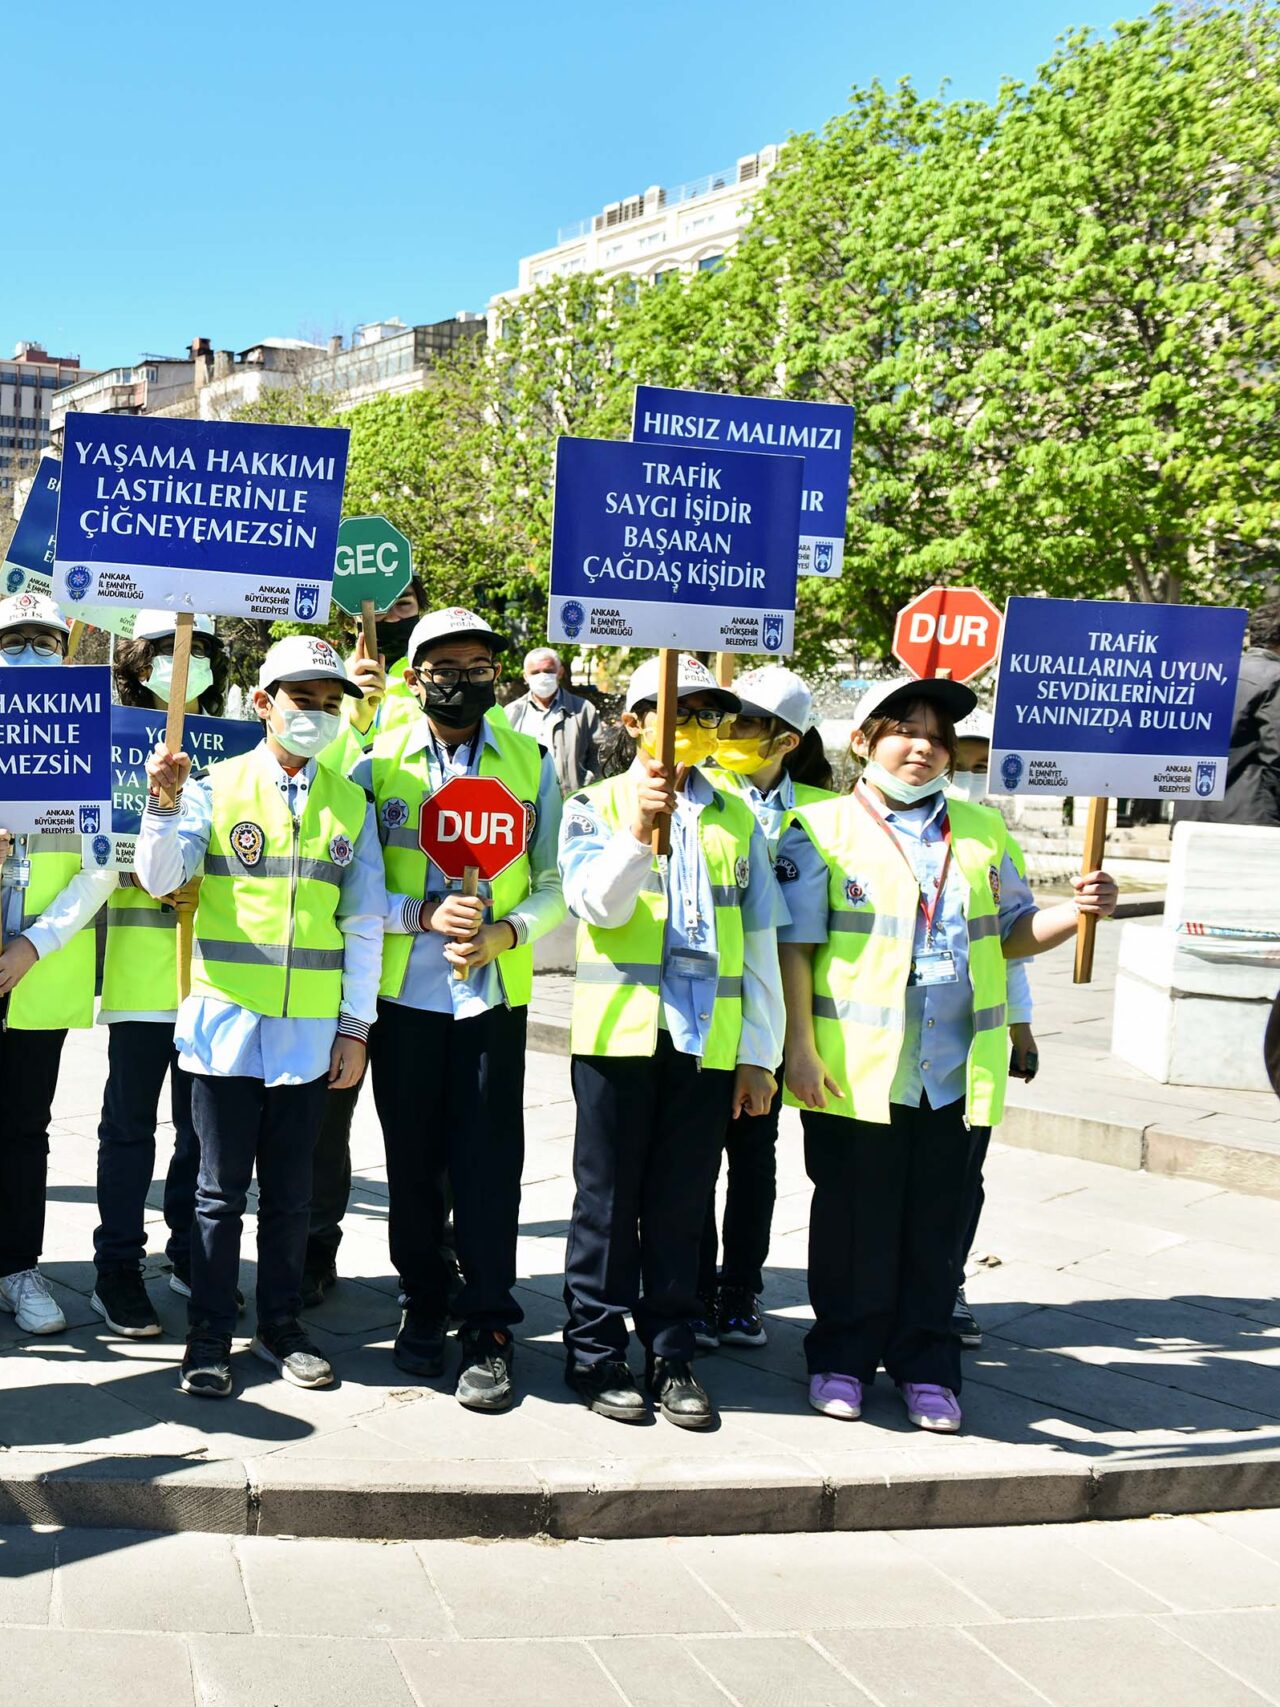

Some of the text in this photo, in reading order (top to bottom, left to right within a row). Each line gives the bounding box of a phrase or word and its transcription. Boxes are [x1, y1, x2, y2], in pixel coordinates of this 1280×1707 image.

[643, 412, 842, 450] HIRSIZ MALIMIZI
[75, 442, 336, 480] YAŞAMA HAKKIMI
[642, 462, 722, 490] TRAFİK
[96, 475, 308, 514] LASTİKLERİNLE
[801, 490, 824, 512] IR
[606, 492, 752, 526] SAYGI İŞİDİR
[79, 505, 317, 549] ÇİĞNEYEMEZSİN
[624, 526, 732, 555] BAŞARAN
[798, 544, 810, 552] ARA
[334, 542, 398, 576] GEÇ
[100, 572, 131, 581] ANKARA
[583, 552, 766, 592] ÇAĞDAŞ KİŞİDİR
[29, 578, 50, 589] ANKARA
[99, 580, 137, 591] İL EMNİYET
[98, 589, 144, 600] MÜDÜRLÜĞÜ
[258, 585, 290, 594] ANKARA
[245, 593, 290, 605] BÜYÜKŞEHİR
[251, 604, 289, 616] BELEDİYESİ
[591, 608, 620, 617] ANKARA
[598, 618, 626, 627] EMNİYET
[732, 617, 759, 626] ANKARA
[590, 625, 632, 636] MÜDÜRLÜĞÜ
[720, 626, 758, 637] BÜYÜKŞEHİR
[909, 613, 989, 647] DUR
[725, 637, 758, 646] BELEDİYESİ
[1088, 630, 1159, 654] TRAFİK
[312, 657, 337, 668] POLİS
[1010, 654, 1228, 686] KURALLARINA UYUN,
[1037, 677, 1195, 705] SEVDİKLERİNİZİ
[1016, 705, 1212, 731] YANINIZDA BULUN
[190, 731, 224, 751] VER
[1030, 760, 1057, 769] ANKARA
[1165, 765, 1192, 773] ANKARA
[1036, 770, 1062, 778] EMNİYET
[1153, 773, 1191, 783] BÜYÜKŞEHİR
[1028, 777, 1068, 787] MÜDÜRLÜĞÜ
[1159, 784, 1191, 793] BELEDİYESİ
[35, 817, 75, 826] BÜYÜKŞEHİR
[437, 810, 514, 846] DUR
